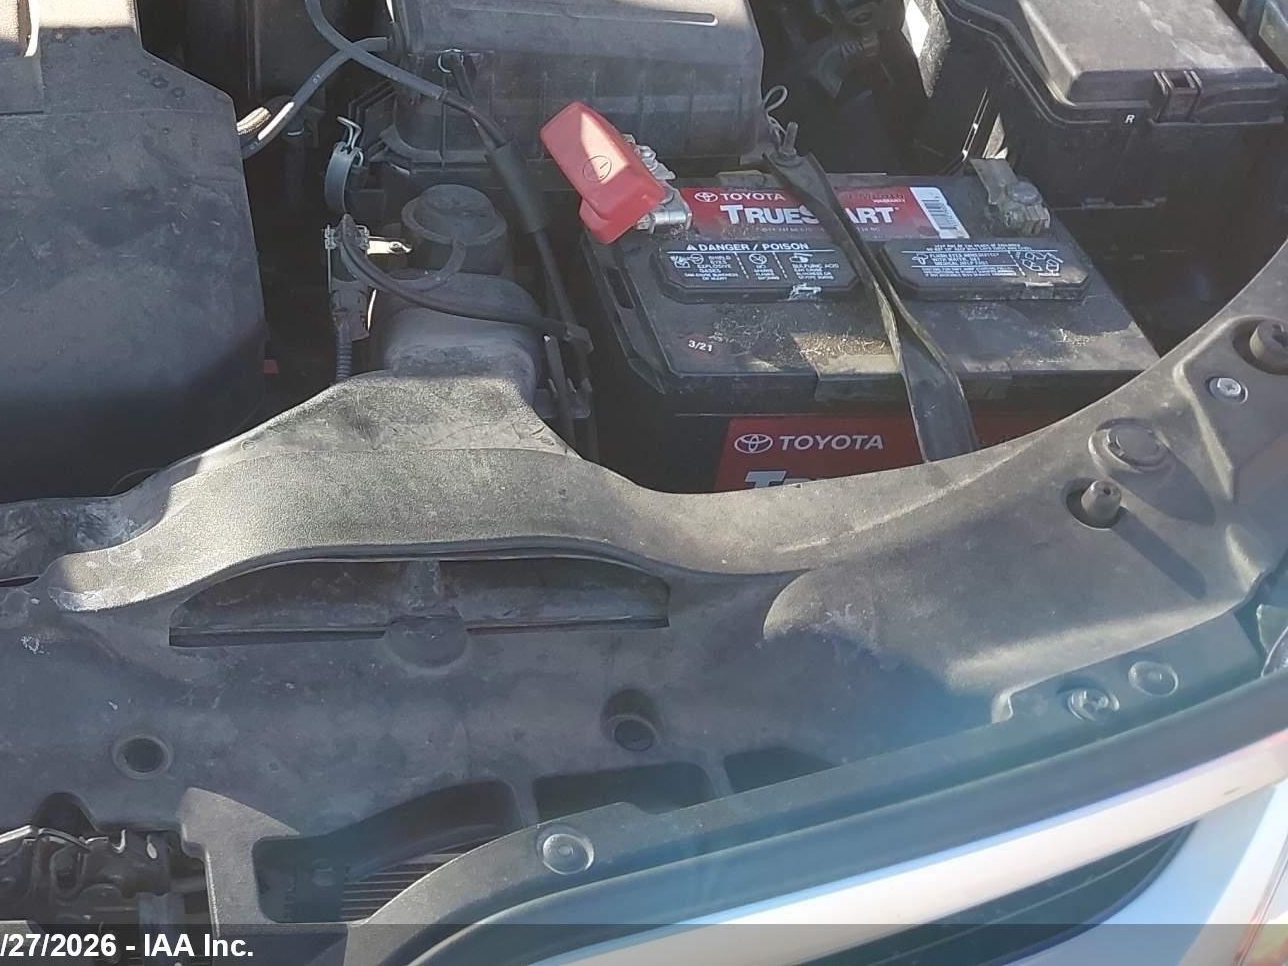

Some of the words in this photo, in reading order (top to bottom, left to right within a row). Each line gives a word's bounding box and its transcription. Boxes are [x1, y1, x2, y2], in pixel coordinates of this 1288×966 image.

[1125, 114, 1136, 124] R
[719, 192, 787, 202] TOYOTA
[698, 243, 751, 251] DANGER
[752, 243, 759, 251] /
[761, 242, 810, 251] POISON
[688, 339, 713, 352] 3/21
[778, 434, 884, 451] TOYOTA
